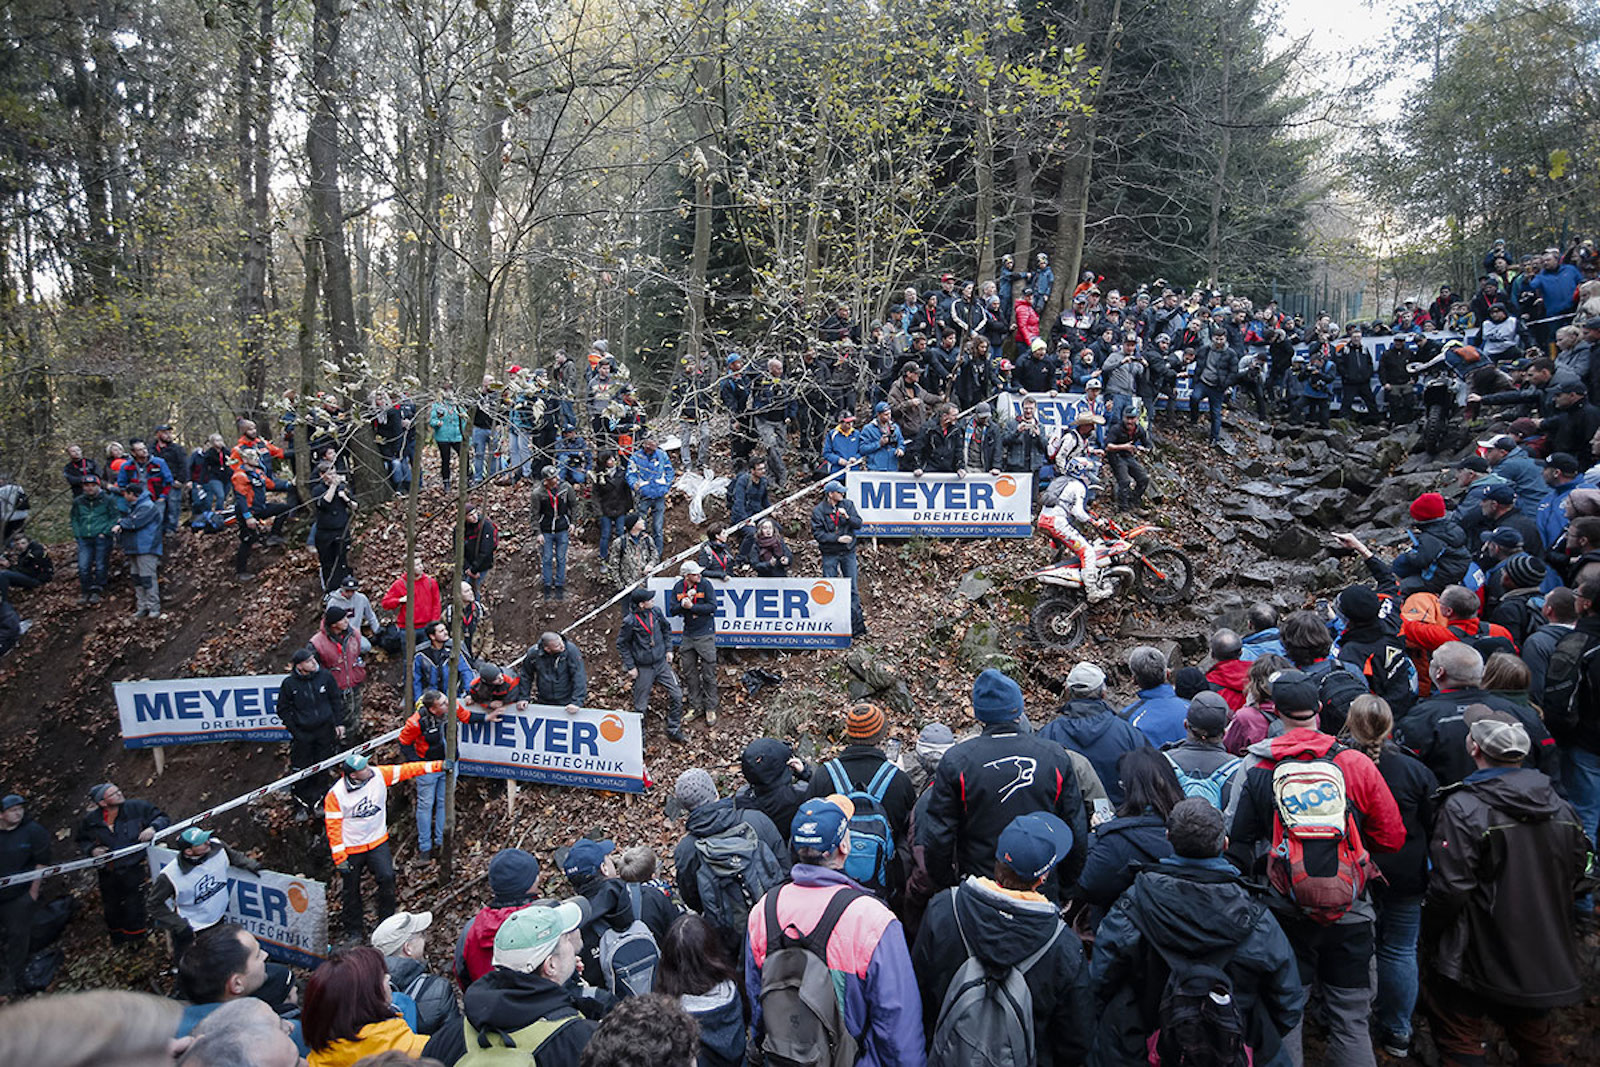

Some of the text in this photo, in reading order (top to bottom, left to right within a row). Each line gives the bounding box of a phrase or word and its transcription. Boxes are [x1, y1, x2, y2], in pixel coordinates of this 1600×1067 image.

[861, 482, 994, 509] MEYER
[913, 511, 1015, 521] DREHTECHNIK
[722, 620, 833, 632] DREHTECHNIK
[511, 751, 624, 773] DREHTECHNIK
